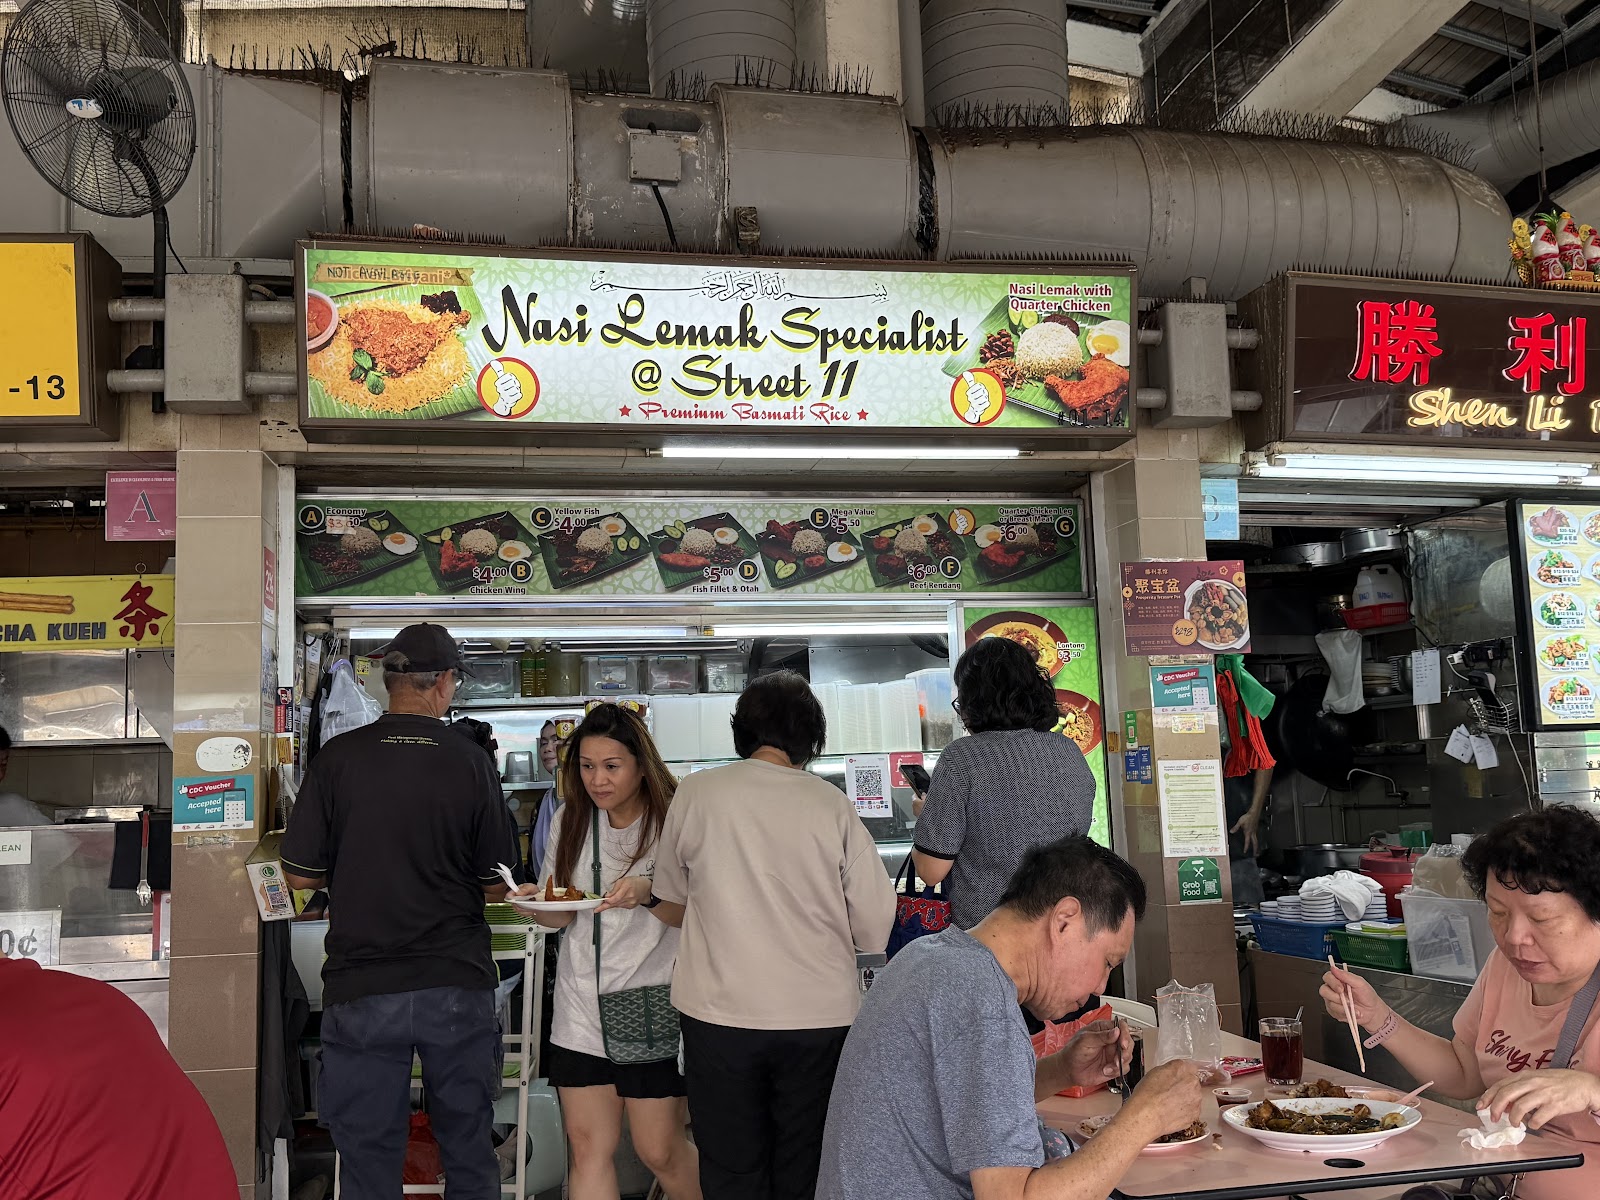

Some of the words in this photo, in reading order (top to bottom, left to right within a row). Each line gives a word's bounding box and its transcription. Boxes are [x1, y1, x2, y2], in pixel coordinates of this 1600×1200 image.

[1009, 283, 1036, 295] Nasi
[1040, 284, 1080, 295] Lemak
[1084, 285, 1112, 296] with
[1011, 299, 1059, 312] Quarter
[1063, 300, 1111, 311] Chicken
[482, 284, 592, 352] Nasi
[600, 294, 768, 348] Lemak
[771, 307, 969, 363] Specialist
[631, 359, 662, 391] @
[671, 354, 812, 397] Street
[822, 360, 859, 398] 11
[638, 400, 728, 421] Premium
[732, 403, 806, 421] Basmati
[810, 403, 852, 424] Rice
[1407, 387, 1517, 428] Shen
[1526, 396, 1571, 432] Li
[125, 490, 160, 522] A
[326, 507, 367, 517] Economy
[554, 507, 582, 516] Yellow
[998, 508, 1028, 516] Quarter
[1029, 507, 1058, 515] Chicken
[1059, 508, 1073, 517] Leg
[305, 510, 318, 523] A
[535, 511, 546, 523] C
[815, 511, 824, 523] E
[831, 508, 853, 517] Mega
[854, 508, 875, 516] Value
[1009, 515, 1033, 523] Breast
[554, 517, 587, 534] $4.00
[830, 517, 860, 534] $5.50
[1060, 520, 1070, 532] G
[1000, 525, 1028, 541] $6.00
[516, 564, 526, 577] B
[743, 564, 754, 576] D
[907, 565, 937, 581] $6.00
[946, 561, 955, 573] F
[472, 566, 508, 584] $4.00
[703, 567, 734, 582] $5.00
[469, 586, 503, 594] Chicken
[504, 586, 526, 595] Wing
[928, 582, 961, 590] Rendang
[1134, 578, 1181, 594] 聚宝盆
[112, 580, 168, 641] 条
[48, 622, 107, 640] KUEH
[1057, 642, 1085, 650] Lontong
[1163, 674, 1175, 682] CDC
[1175, 671, 1197, 679] Voucher
[1164, 684, 1190, 695] Accepted
[188, 786, 204, 794] CDC
[204, 782, 232, 792] Voucher
[187, 797, 222, 809] Accepted
[204, 806, 222, 815] here
[1182, 881, 1200, 890] Grab
